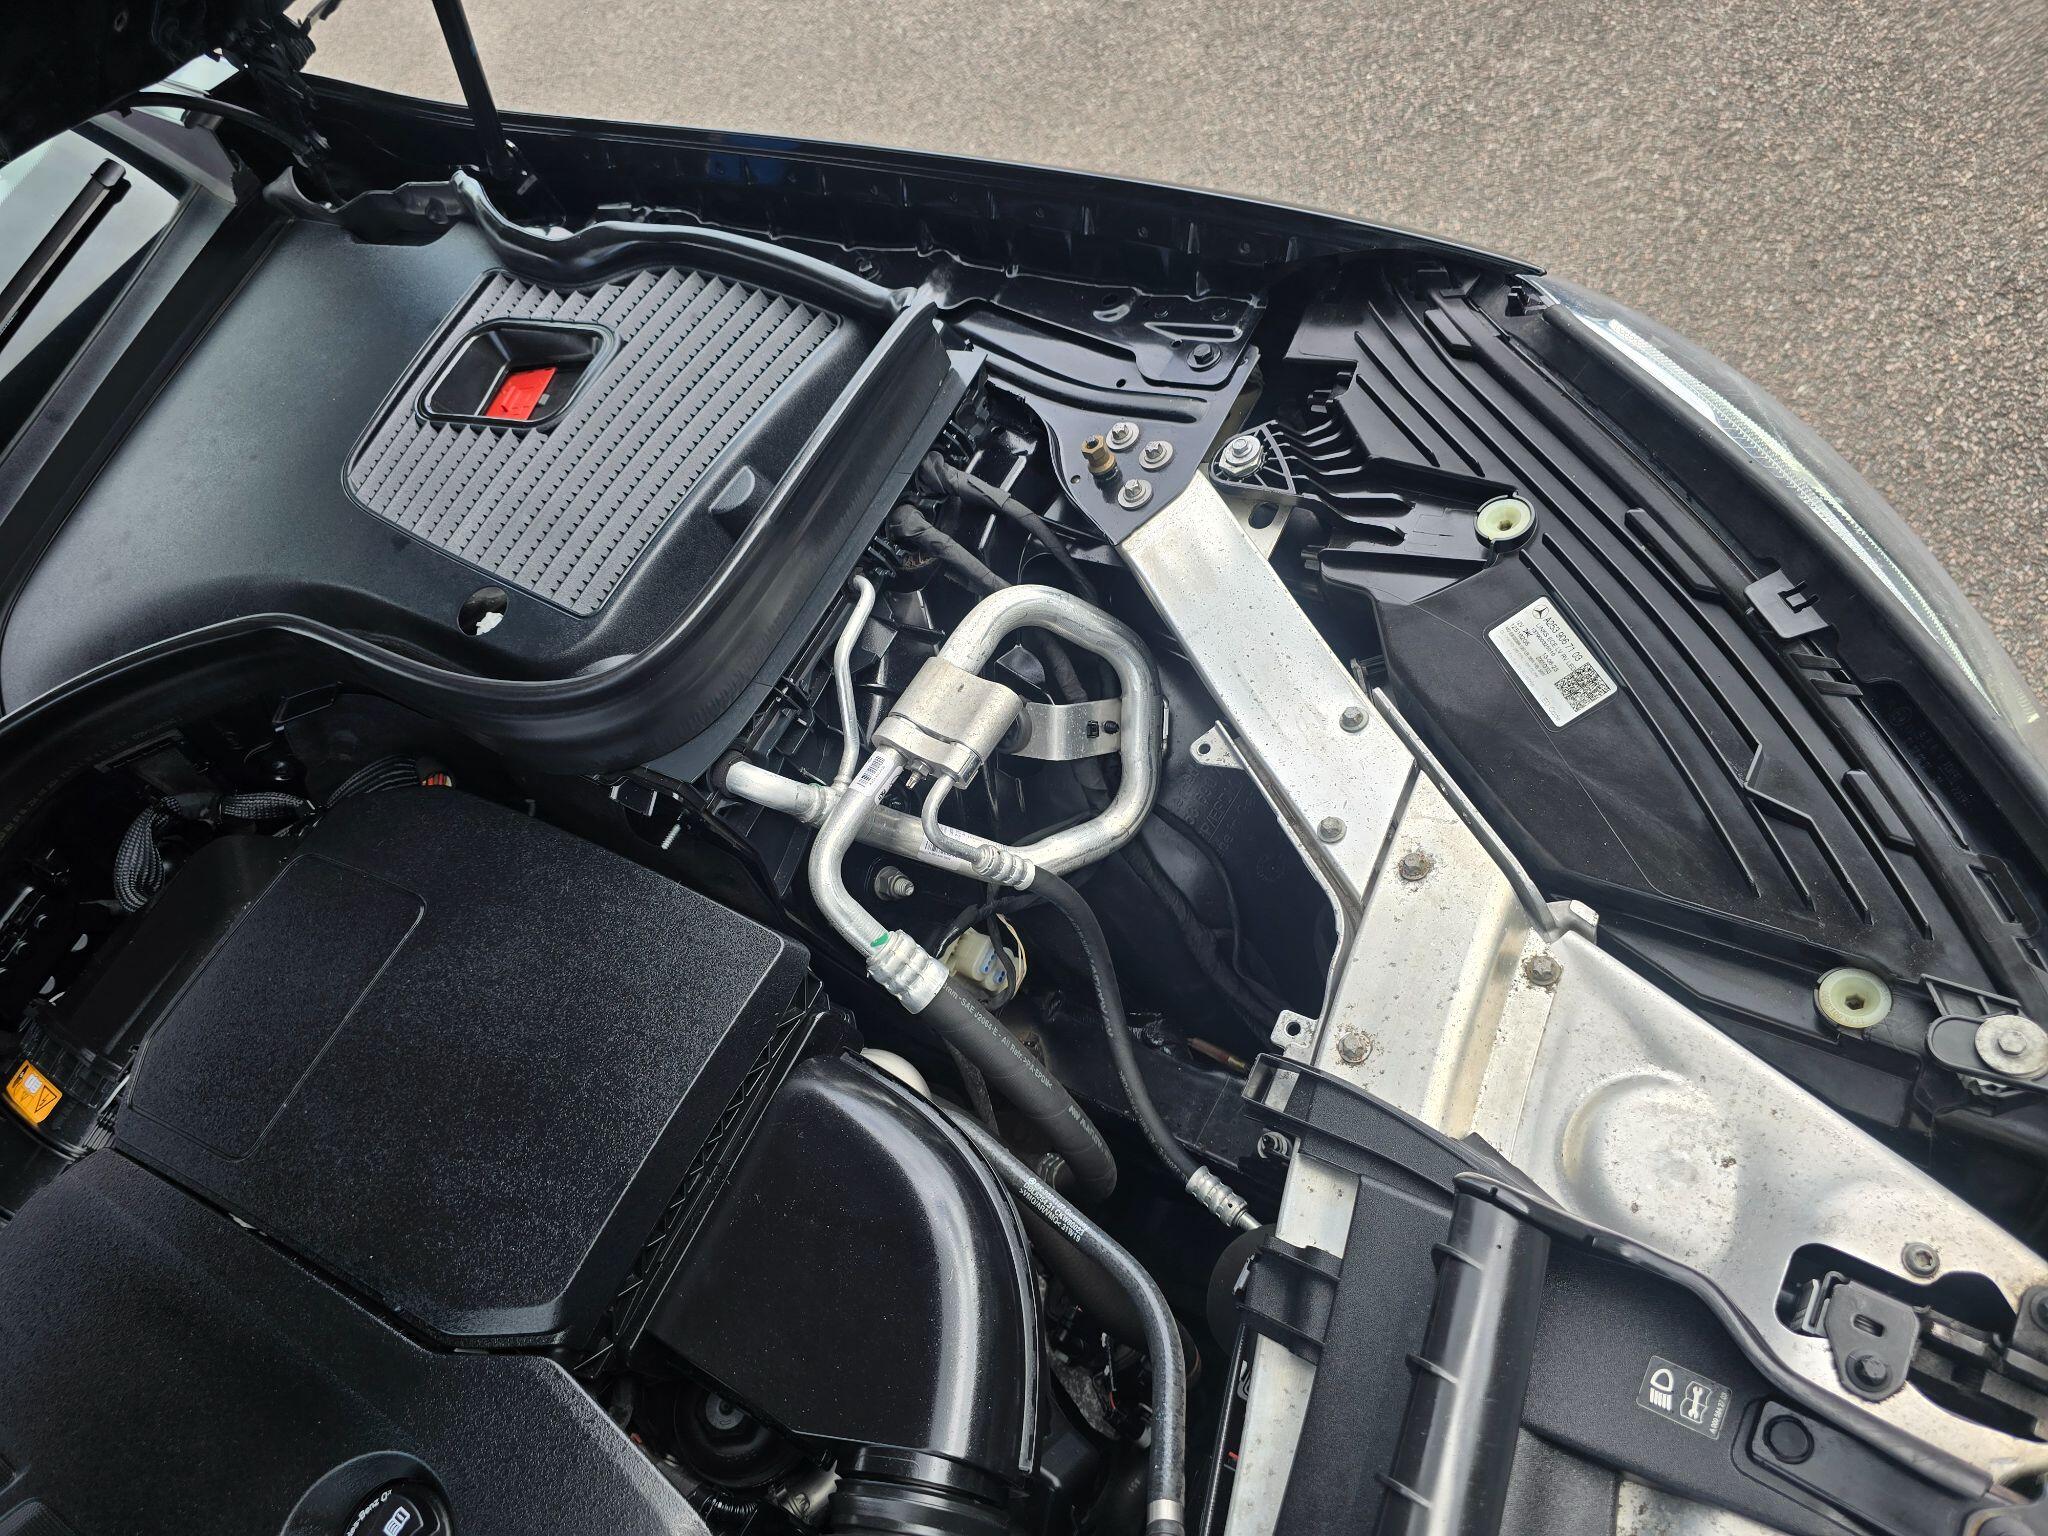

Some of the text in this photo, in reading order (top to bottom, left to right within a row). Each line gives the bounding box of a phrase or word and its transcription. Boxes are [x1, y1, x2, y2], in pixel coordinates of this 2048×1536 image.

[1542, 615, 1583, 662] A253 906 71 03
[959, 997, 976, 1014] SAE
